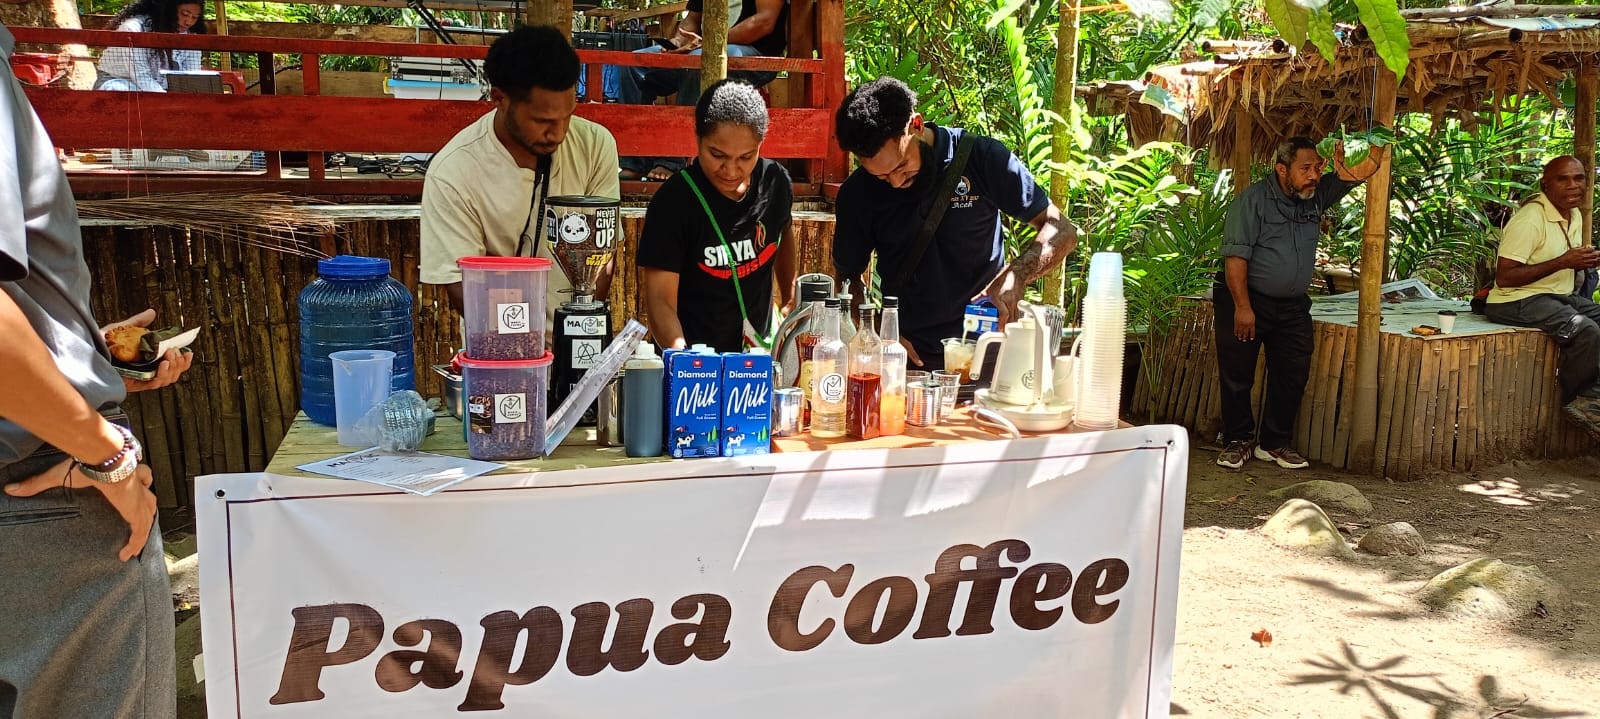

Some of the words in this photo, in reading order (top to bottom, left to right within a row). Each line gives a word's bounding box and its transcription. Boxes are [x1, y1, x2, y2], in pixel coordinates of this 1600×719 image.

[596, 209, 616, 218] NEVER
[596, 217, 616, 228] GIVE
[596, 228, 615, 248] UP
[677, 370, 717, 378] Diamond
[729, 370, 768, 378] Diamond
[676, 381, 718, 416] Milk
[726, 381, 768, 416] Milk
[269, 593, 732, 712] Papua
[767, 538, 1130, 653] Coffee
